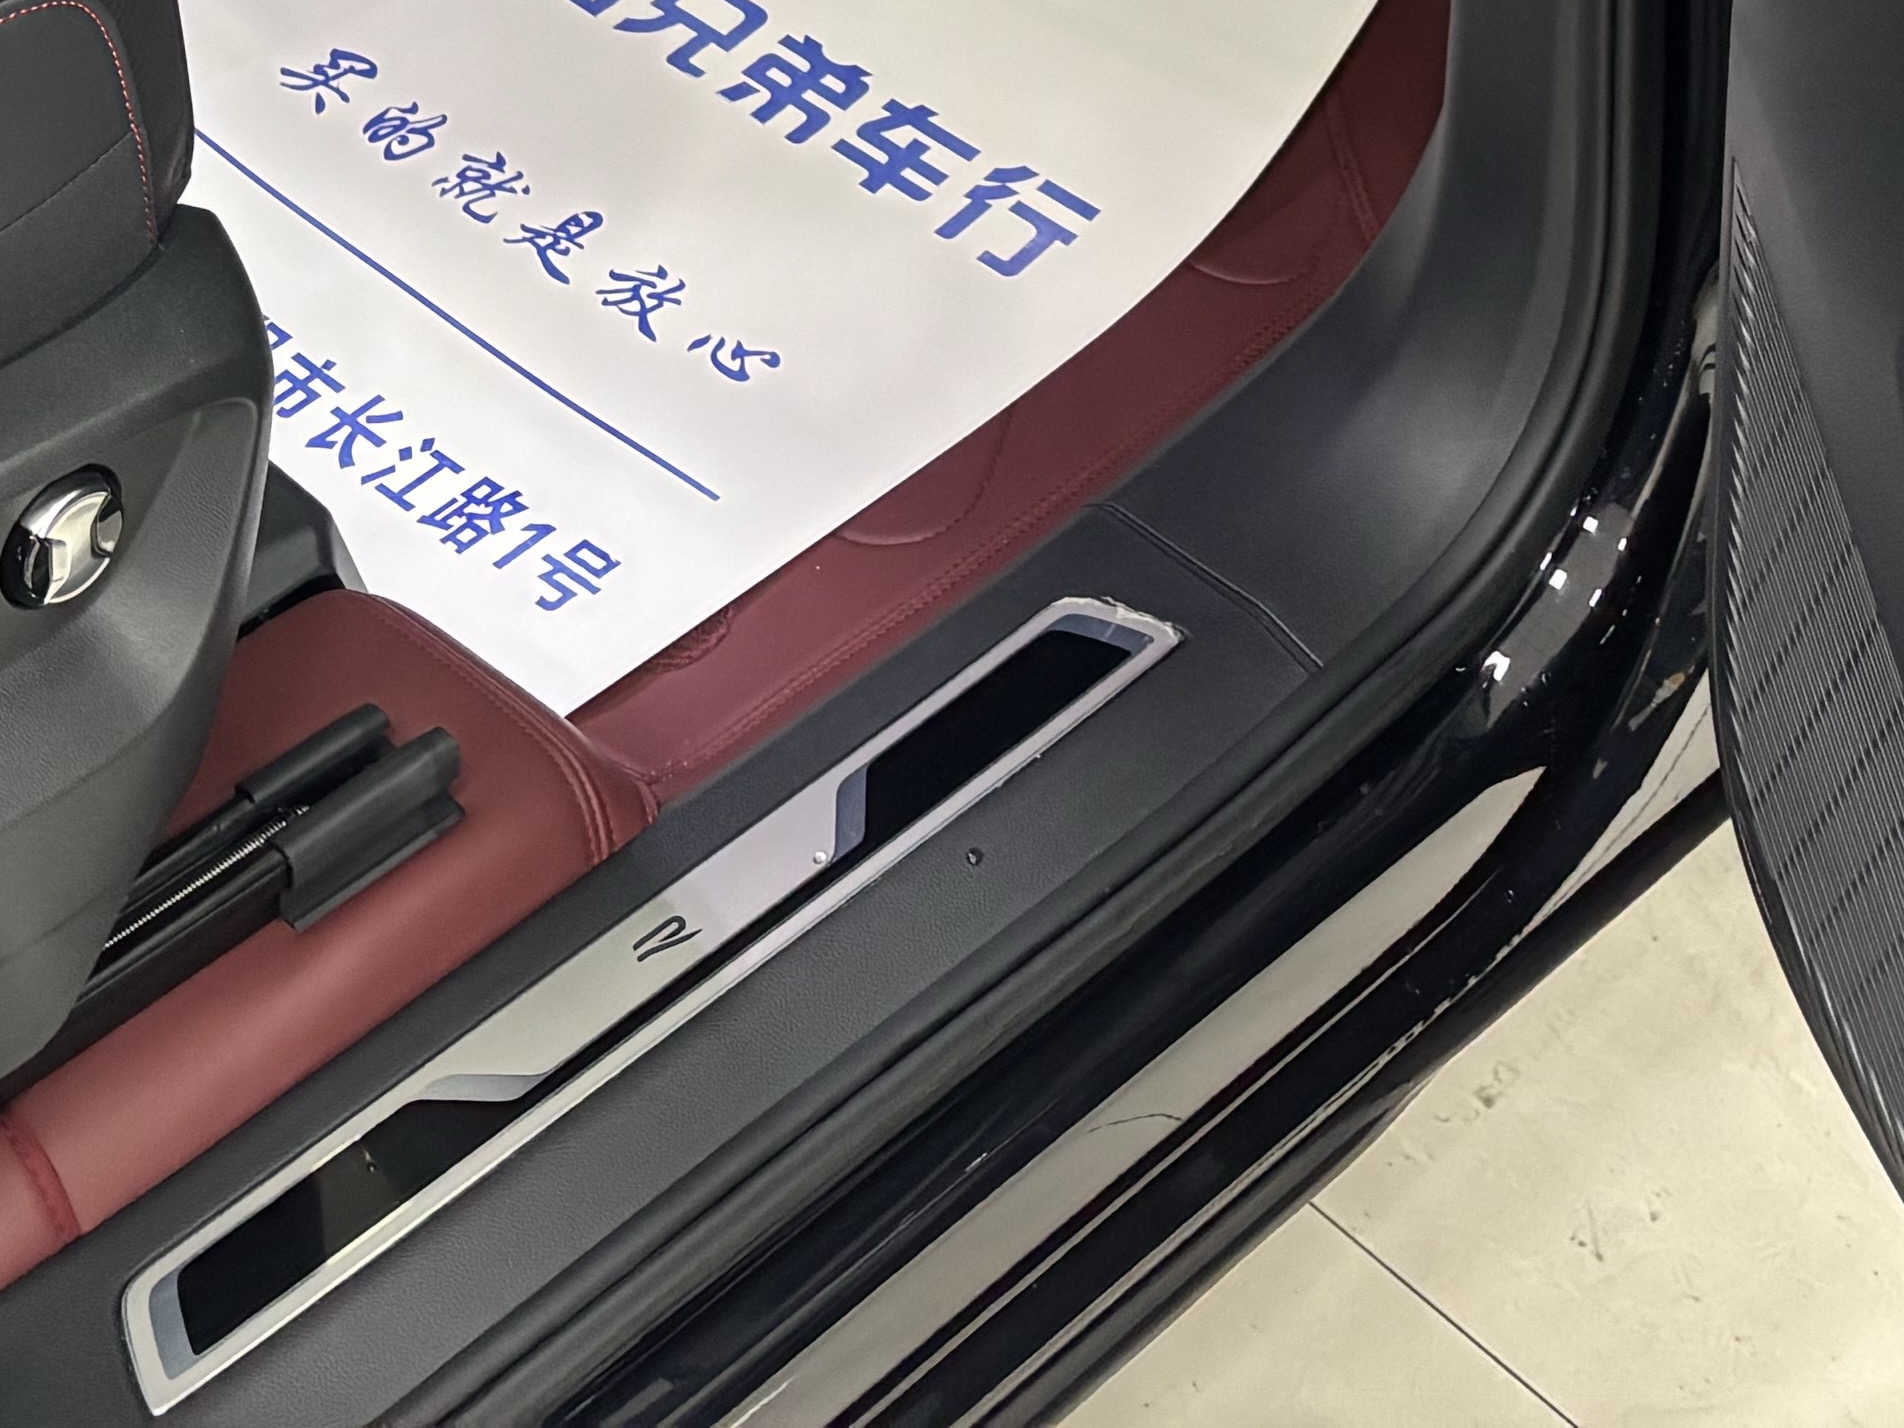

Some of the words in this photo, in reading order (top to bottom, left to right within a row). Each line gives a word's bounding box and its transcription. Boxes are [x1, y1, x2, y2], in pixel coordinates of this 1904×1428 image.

[280, 48, 781, 384] 买的就是放心
